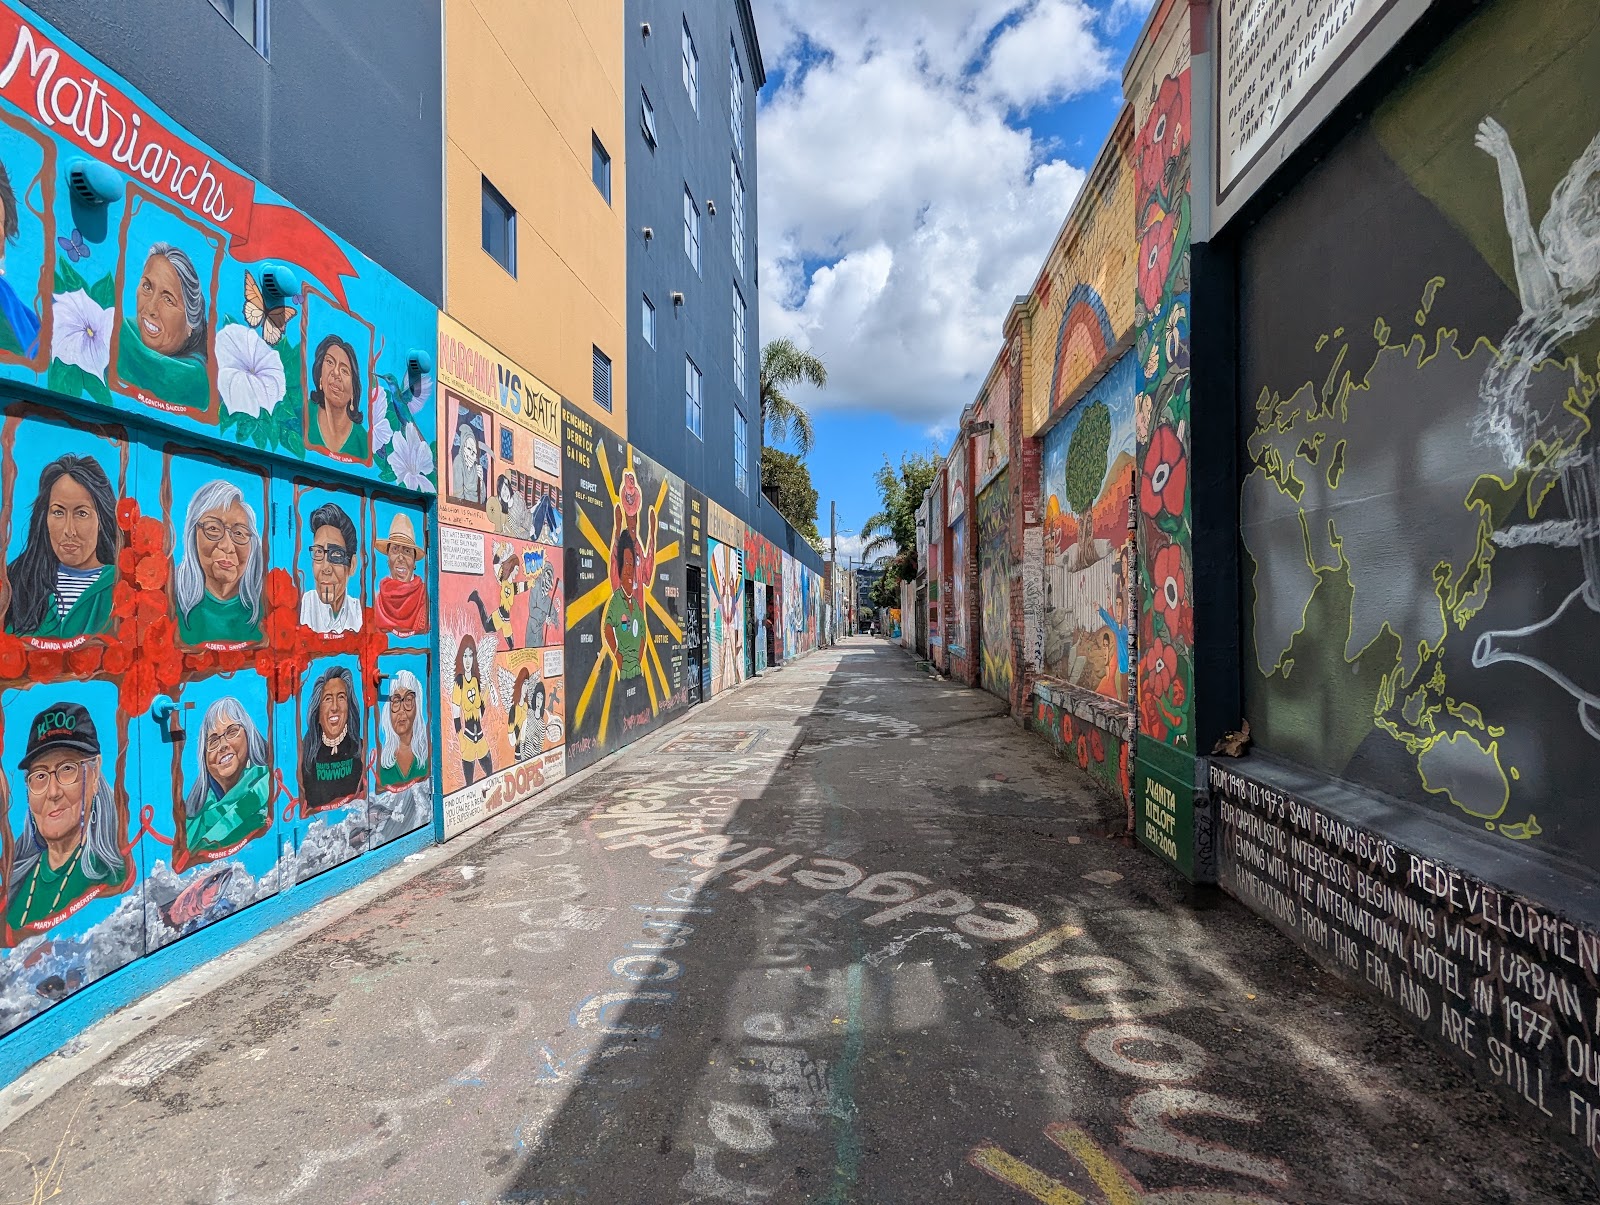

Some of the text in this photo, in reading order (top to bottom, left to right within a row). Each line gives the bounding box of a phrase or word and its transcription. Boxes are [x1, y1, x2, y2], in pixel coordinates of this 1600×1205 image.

[1229, 30, 1243, 60] OUR
[1229, 4, 1286, 97] ORGANIZATION
[1229, 24, 1259, 79] DIVERSE
[1229, 15, 1302, 125] PLEASE CONTACT
[1239, 0, 1355, 151] PAINT ON THE ALLEY
[1240, 104, 1255, 132] USE
[1258, 77, 1275, 109] ANY
[1279, 0, 1343, 82] PHOTOGRAP
[1, 24, 234, 222] Matriarchs
[440, 331, 497, 400] NARCANIA
[497, 363, 521, 415] VS
[524, 381, 558, 439] DEATH
[562, 408, 593, 438] REMEMBER
[566, 427, 593, 454] DERRICK
[566, 445, 591, 469] GAINES
[580, 478, 597, 493] RESPECT
[524, 550, 544, 575] POW
[204, 642, 226, 651] ALBERTA
[580, 634, 593, 643] BREAD
[654, 634, 669, 644] JUSTICE
[316, 765, 353, 780] POWWOW
[503, 758, 545, 802] DOPE
[445, 790, 477, 809] FIND OUT HOW
[446, 808, 455, 818] YOU
[455, 805, 465, 815] CAN
[1145, 777, 1176, 813] JUANITA
[446, 817, 456, 829] LIFE
[208, 851, 227, 860] DEBBIE
[1210, 766, 1600, 975] FROM 1948 TO 1973 SAN FRANCISCO'S REDEVELOPMEN
[33, 888, 101, 930] MARY JEAN ROBERTSON
[1220, 800, 1234, 827] FOR
[1235, 808, 1286, 854] CAPITALISTIC
[1291, 836, 1353, 893] INTERESTS.
[1357, 870, 1436, 939] BEGINNING
[1443, 916, 1491, 972] WITH
[1500, 947, 1583, 1022] URBAN
[1235, 835, 1265, 871] ENDING
[1266, 852, 1289, 887] WITH
[1293, 867, 1314, 903] THE
[1317, 882, 1408, 963] INTERNATIONAL
[1414, 939, 1465, 1000] HOTEL
[1474, 977, 1494, 1017] IN
[1502, 995, 1553, 1051] 1977
[1236, 864, 1296, 927] RAMIFICATIONS
[1301, 907, 1328, 950] FROM
[1332, 927, 1359, 970] THIS
[1365, 949, 1395, 998] ERA
[1400, 973, 1431, 1022] AND
[1441, 1002, 1477, 1060] ARE
[1487, 1036, 1554, 1118] STILL
